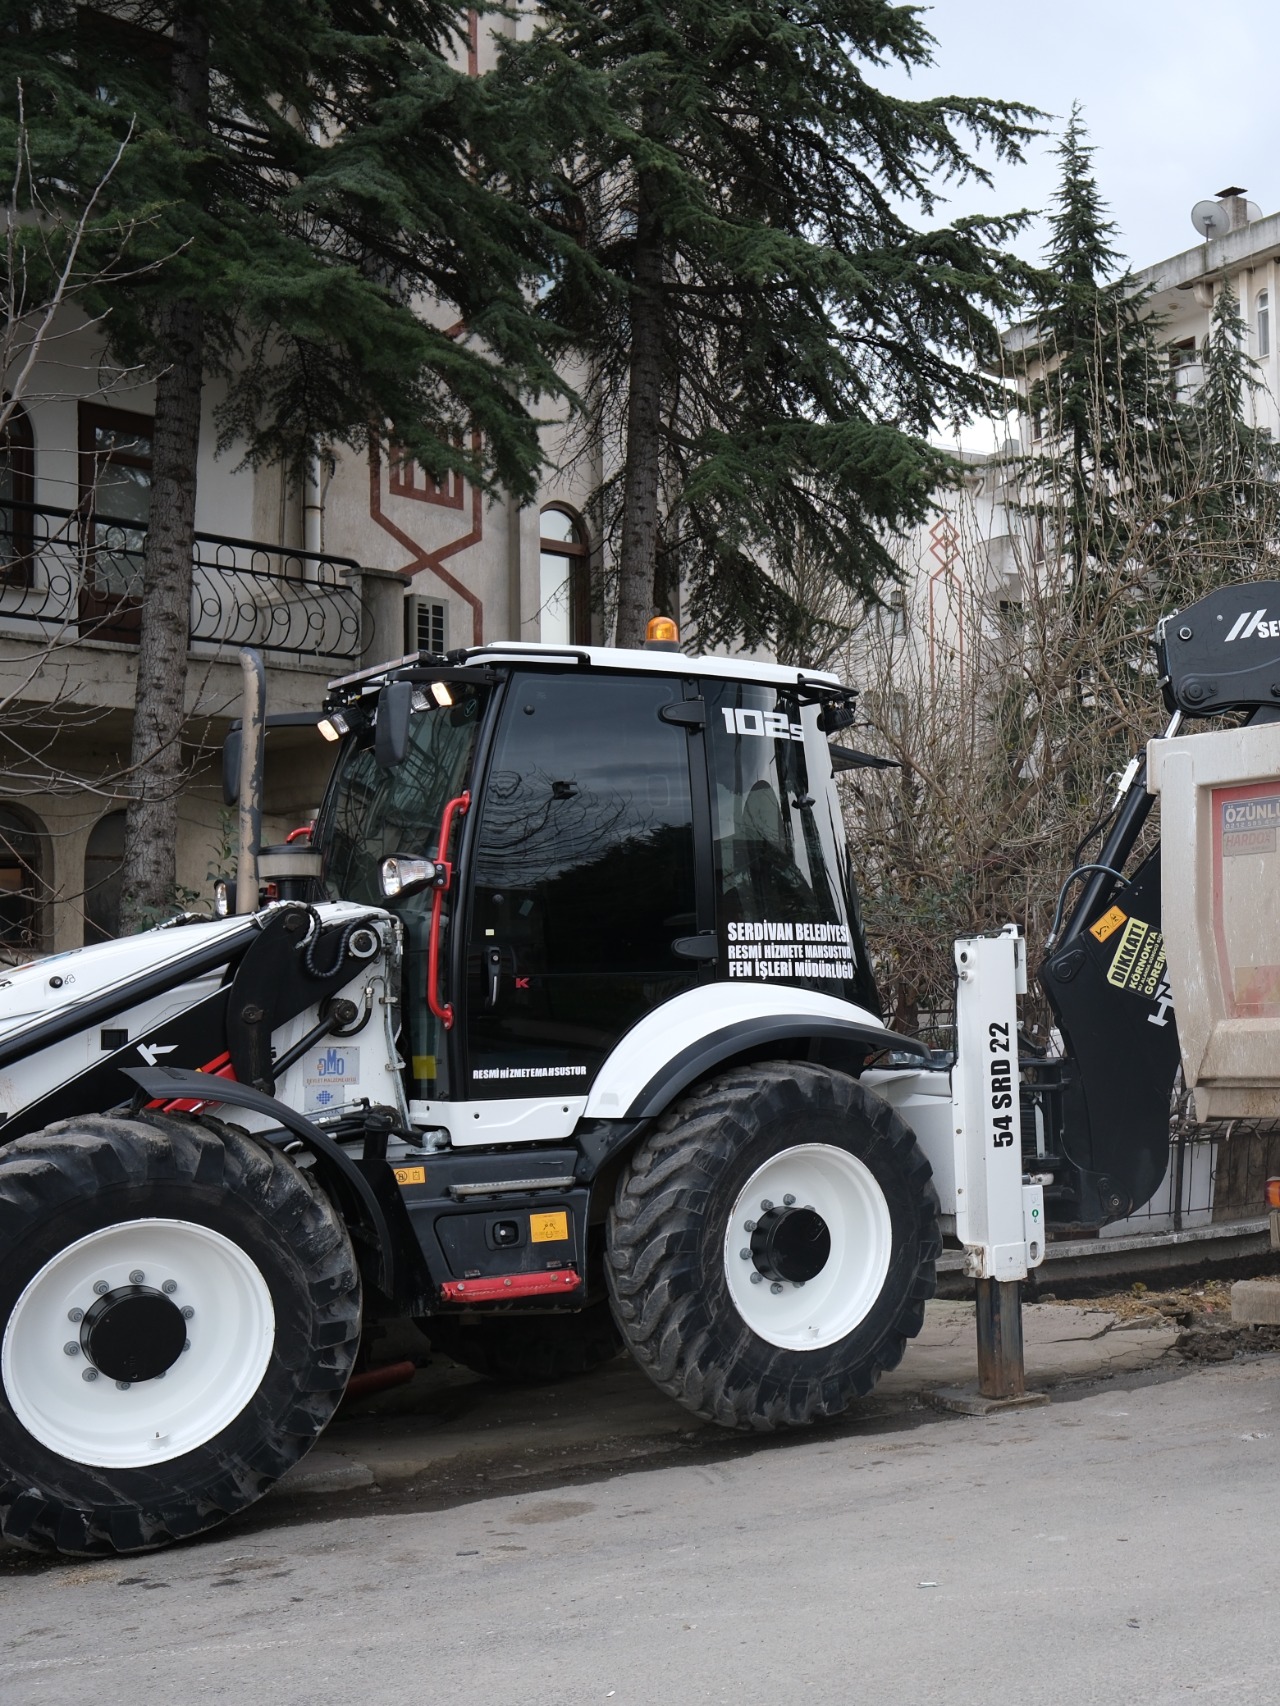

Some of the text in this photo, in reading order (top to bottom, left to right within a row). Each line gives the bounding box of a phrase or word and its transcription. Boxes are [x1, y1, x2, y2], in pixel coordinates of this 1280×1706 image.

[727, 919, 851, 944] SERDİVAN BELEDİYESİ
[728, 942, 852, 960] RESMİ HİZMETE MAHSUSTUR
[1111, 923, 1145, 984] DİKKAT!
[1128, 931, 1158, 990] KÖRNOKTA
[728, 959, 855, 980] FEN İŞLERİ MÜDÜRLÜĞÜ
[472, 1068, 500, 1080] RESMİ
[988, 1022, 1014, 1148] 54 SRD 22
